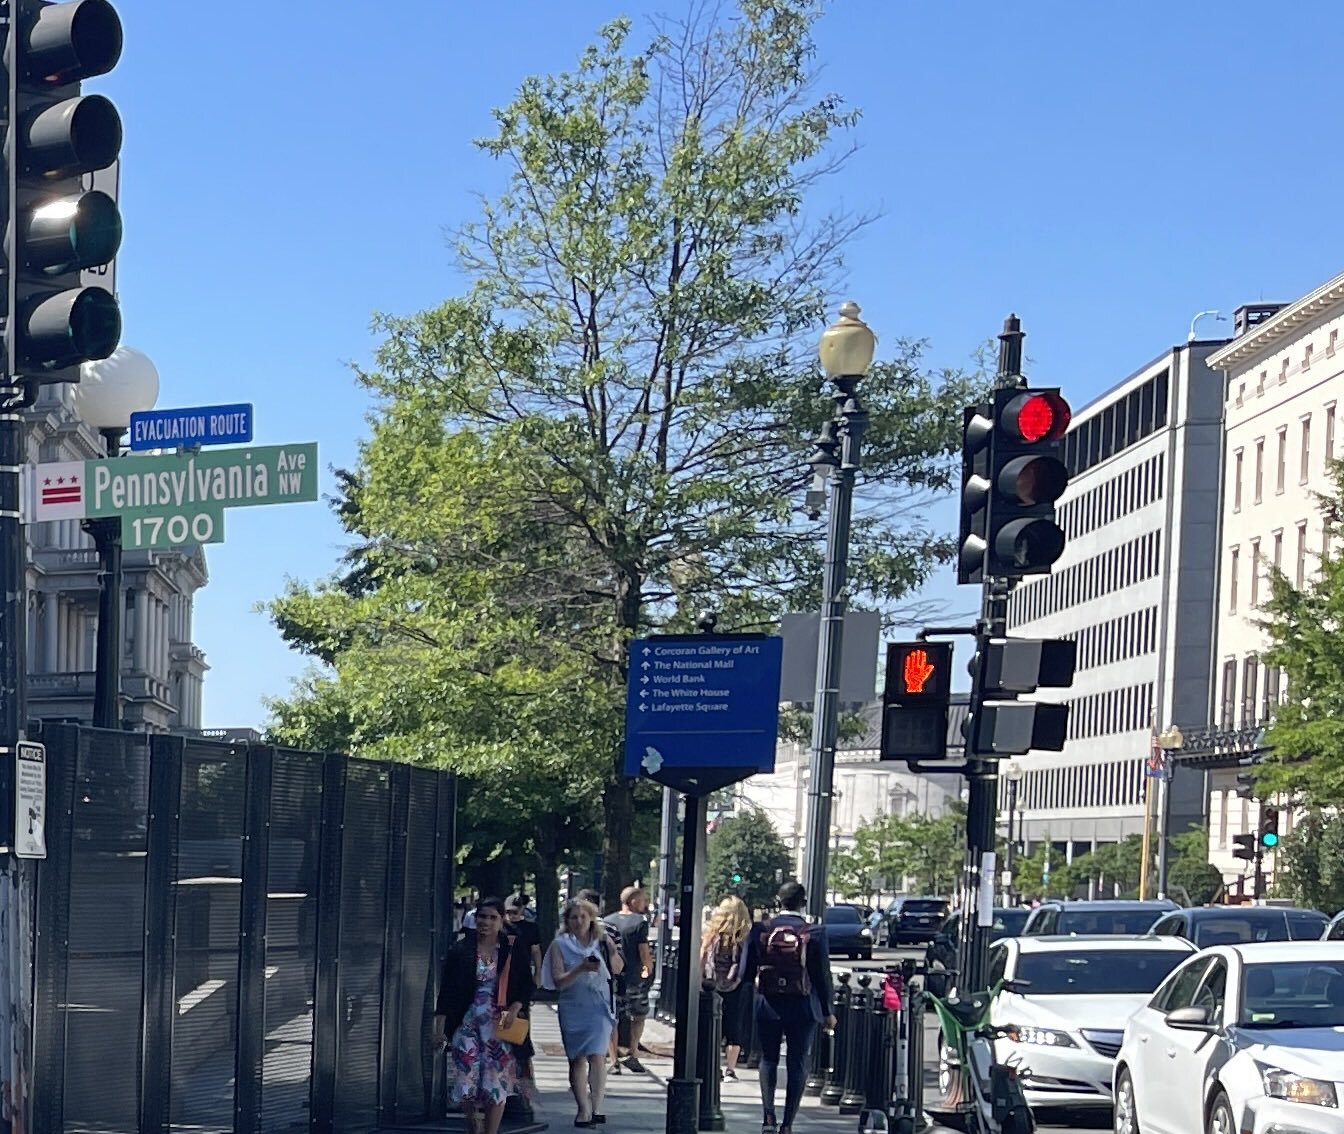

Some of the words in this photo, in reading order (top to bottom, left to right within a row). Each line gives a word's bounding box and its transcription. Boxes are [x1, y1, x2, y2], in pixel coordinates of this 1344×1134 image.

[134, 416, 205, 442] EVACUATION
[210, 413, 247, 436] ROUTE
[94, 453, 269, 510] Pennsylvania
[276, 450, 306, 472] Ave
[278, 472, 303, 495] NW
[132, 513, 213, 546] 1700
[654, 646, 697, 656] Corcoran
[698, 645, 731, 657] Gallery
[732, 645, 744, 655] of
[744, 645, 760, 654] Art
[653, 660, 672, 670] The
[672, 660, 713, 669] National
[713, 659, 735, 669] Mall
[652, 674, 681, 684] World
[682, 674, 705, 683] Bank
[652, 688, 670, 698] The
[670, 688, 699, 697] White
[699, 688, 730, 697] House
[651, 703, 694, 713] Lafayette
[695, 702, 729, 713] Square
[21, 747, 42, 761] NOTICE
